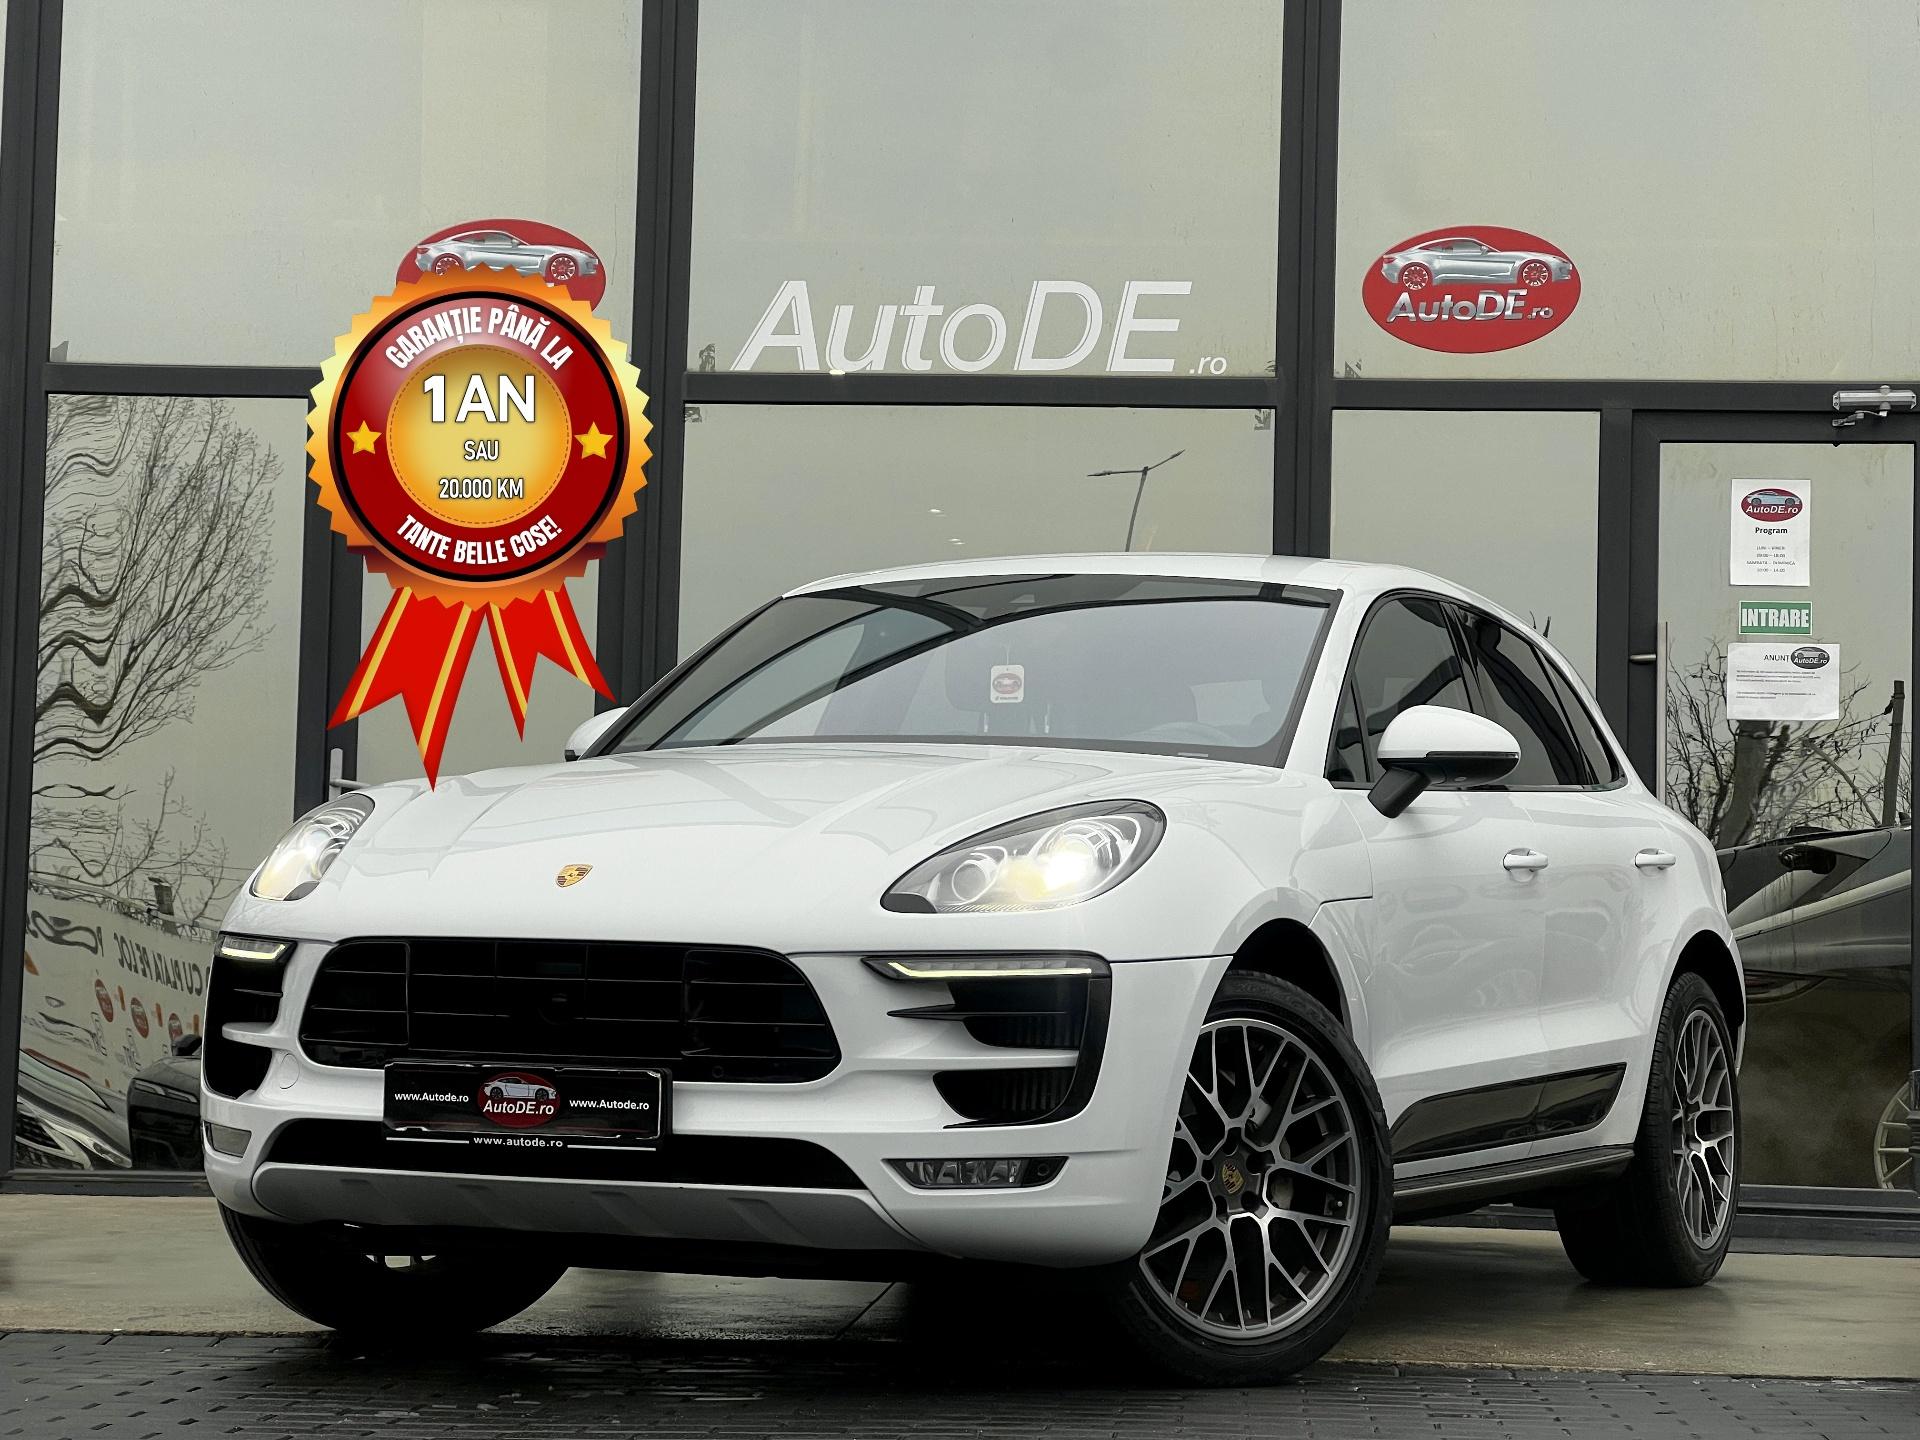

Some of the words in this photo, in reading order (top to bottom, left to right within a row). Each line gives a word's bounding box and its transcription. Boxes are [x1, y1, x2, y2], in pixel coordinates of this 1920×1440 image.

[1746, 504, 1799, 515] AutoDE.ro
[1755, 527, 1788, 535] Program
[1741, 608, 1809, 628] INTRARE
[1793, 656, 1828, 665] AutoDE.ro
[394, 1091, 469, 1103] www.Autode.ro
[482, 1099, 555, 1116] AutoDE.ro
[569, 1098, 650, 1110] www.Autode.ro
[473, 1135, 564, 1148] www.autode.ro
